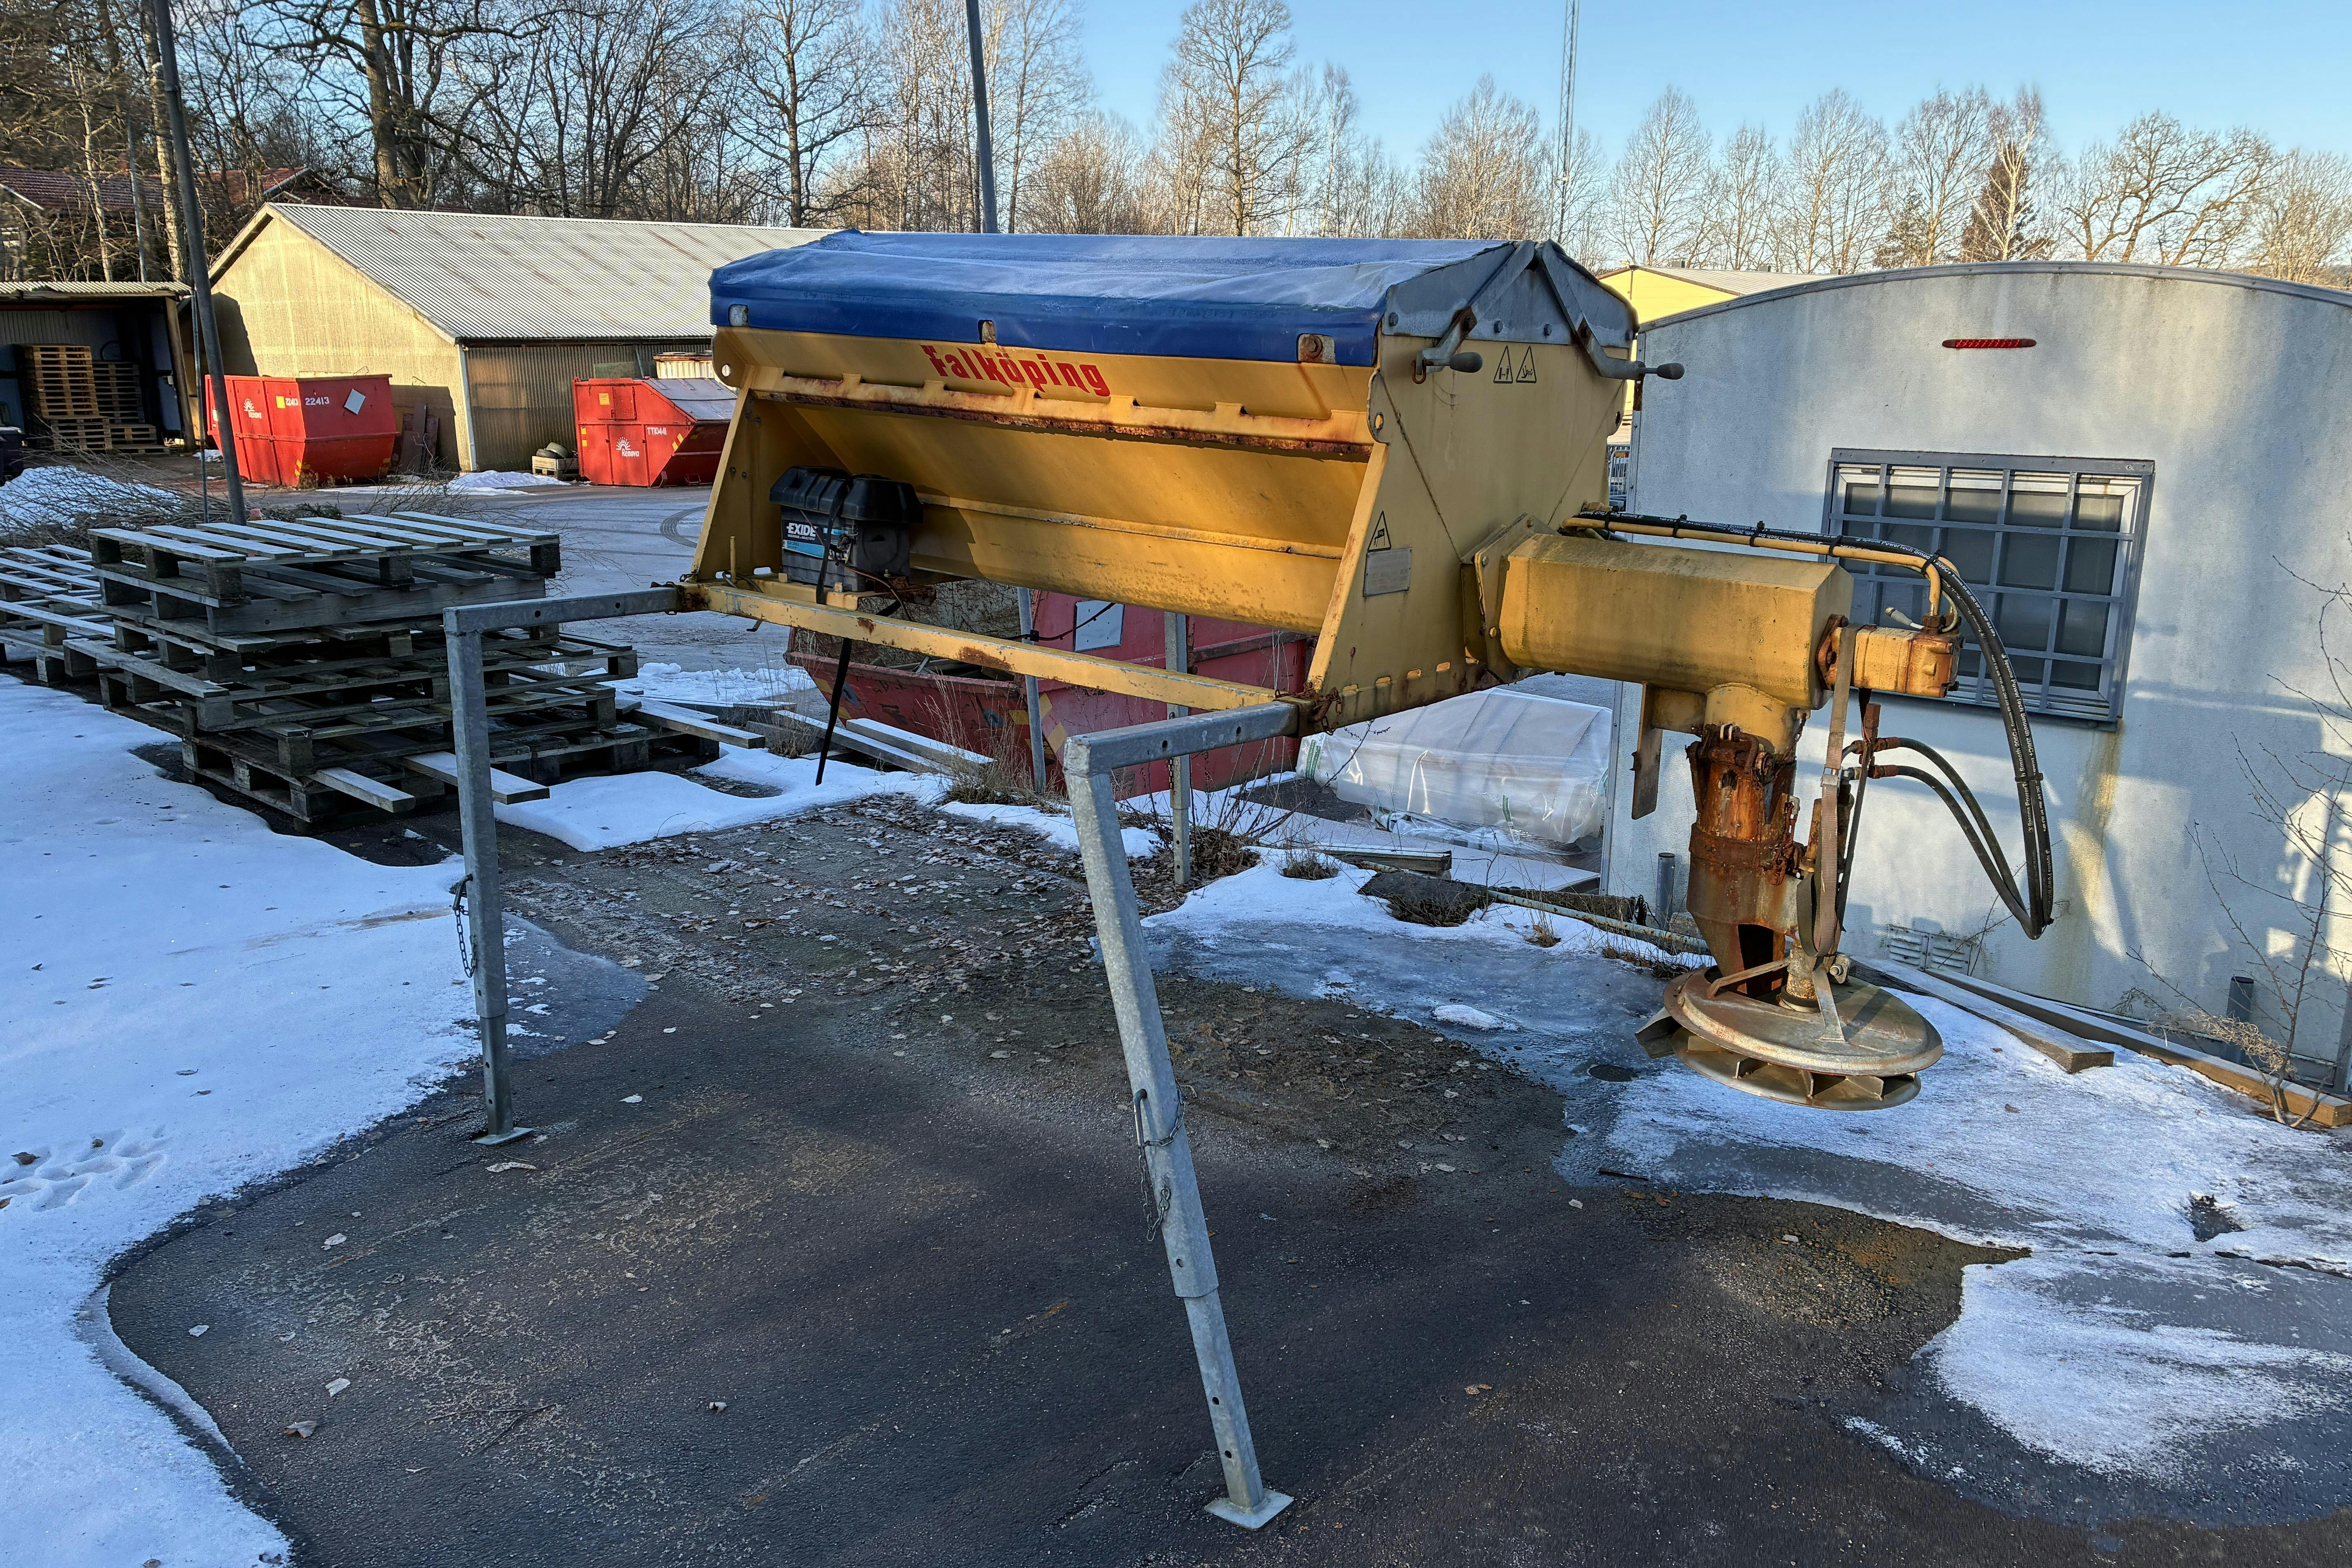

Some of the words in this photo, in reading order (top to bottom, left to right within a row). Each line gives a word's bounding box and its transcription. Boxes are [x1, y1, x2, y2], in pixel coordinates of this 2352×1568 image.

[921, 345, 1110, 396] Falköping
[285, 397, 299, 406] 22413
[305, 397, 329, 406] 22413
[621, 448, 639, 457] Renova
[786, 523, 816, 537] EXIDE
[1881, 540, 1913, 552] PowerTech
[2011, 679, 2024, 712] PowerTech
[2020, 713, 2030, 737] Smooth
[2016, 747, 2025, 772] Smooth
